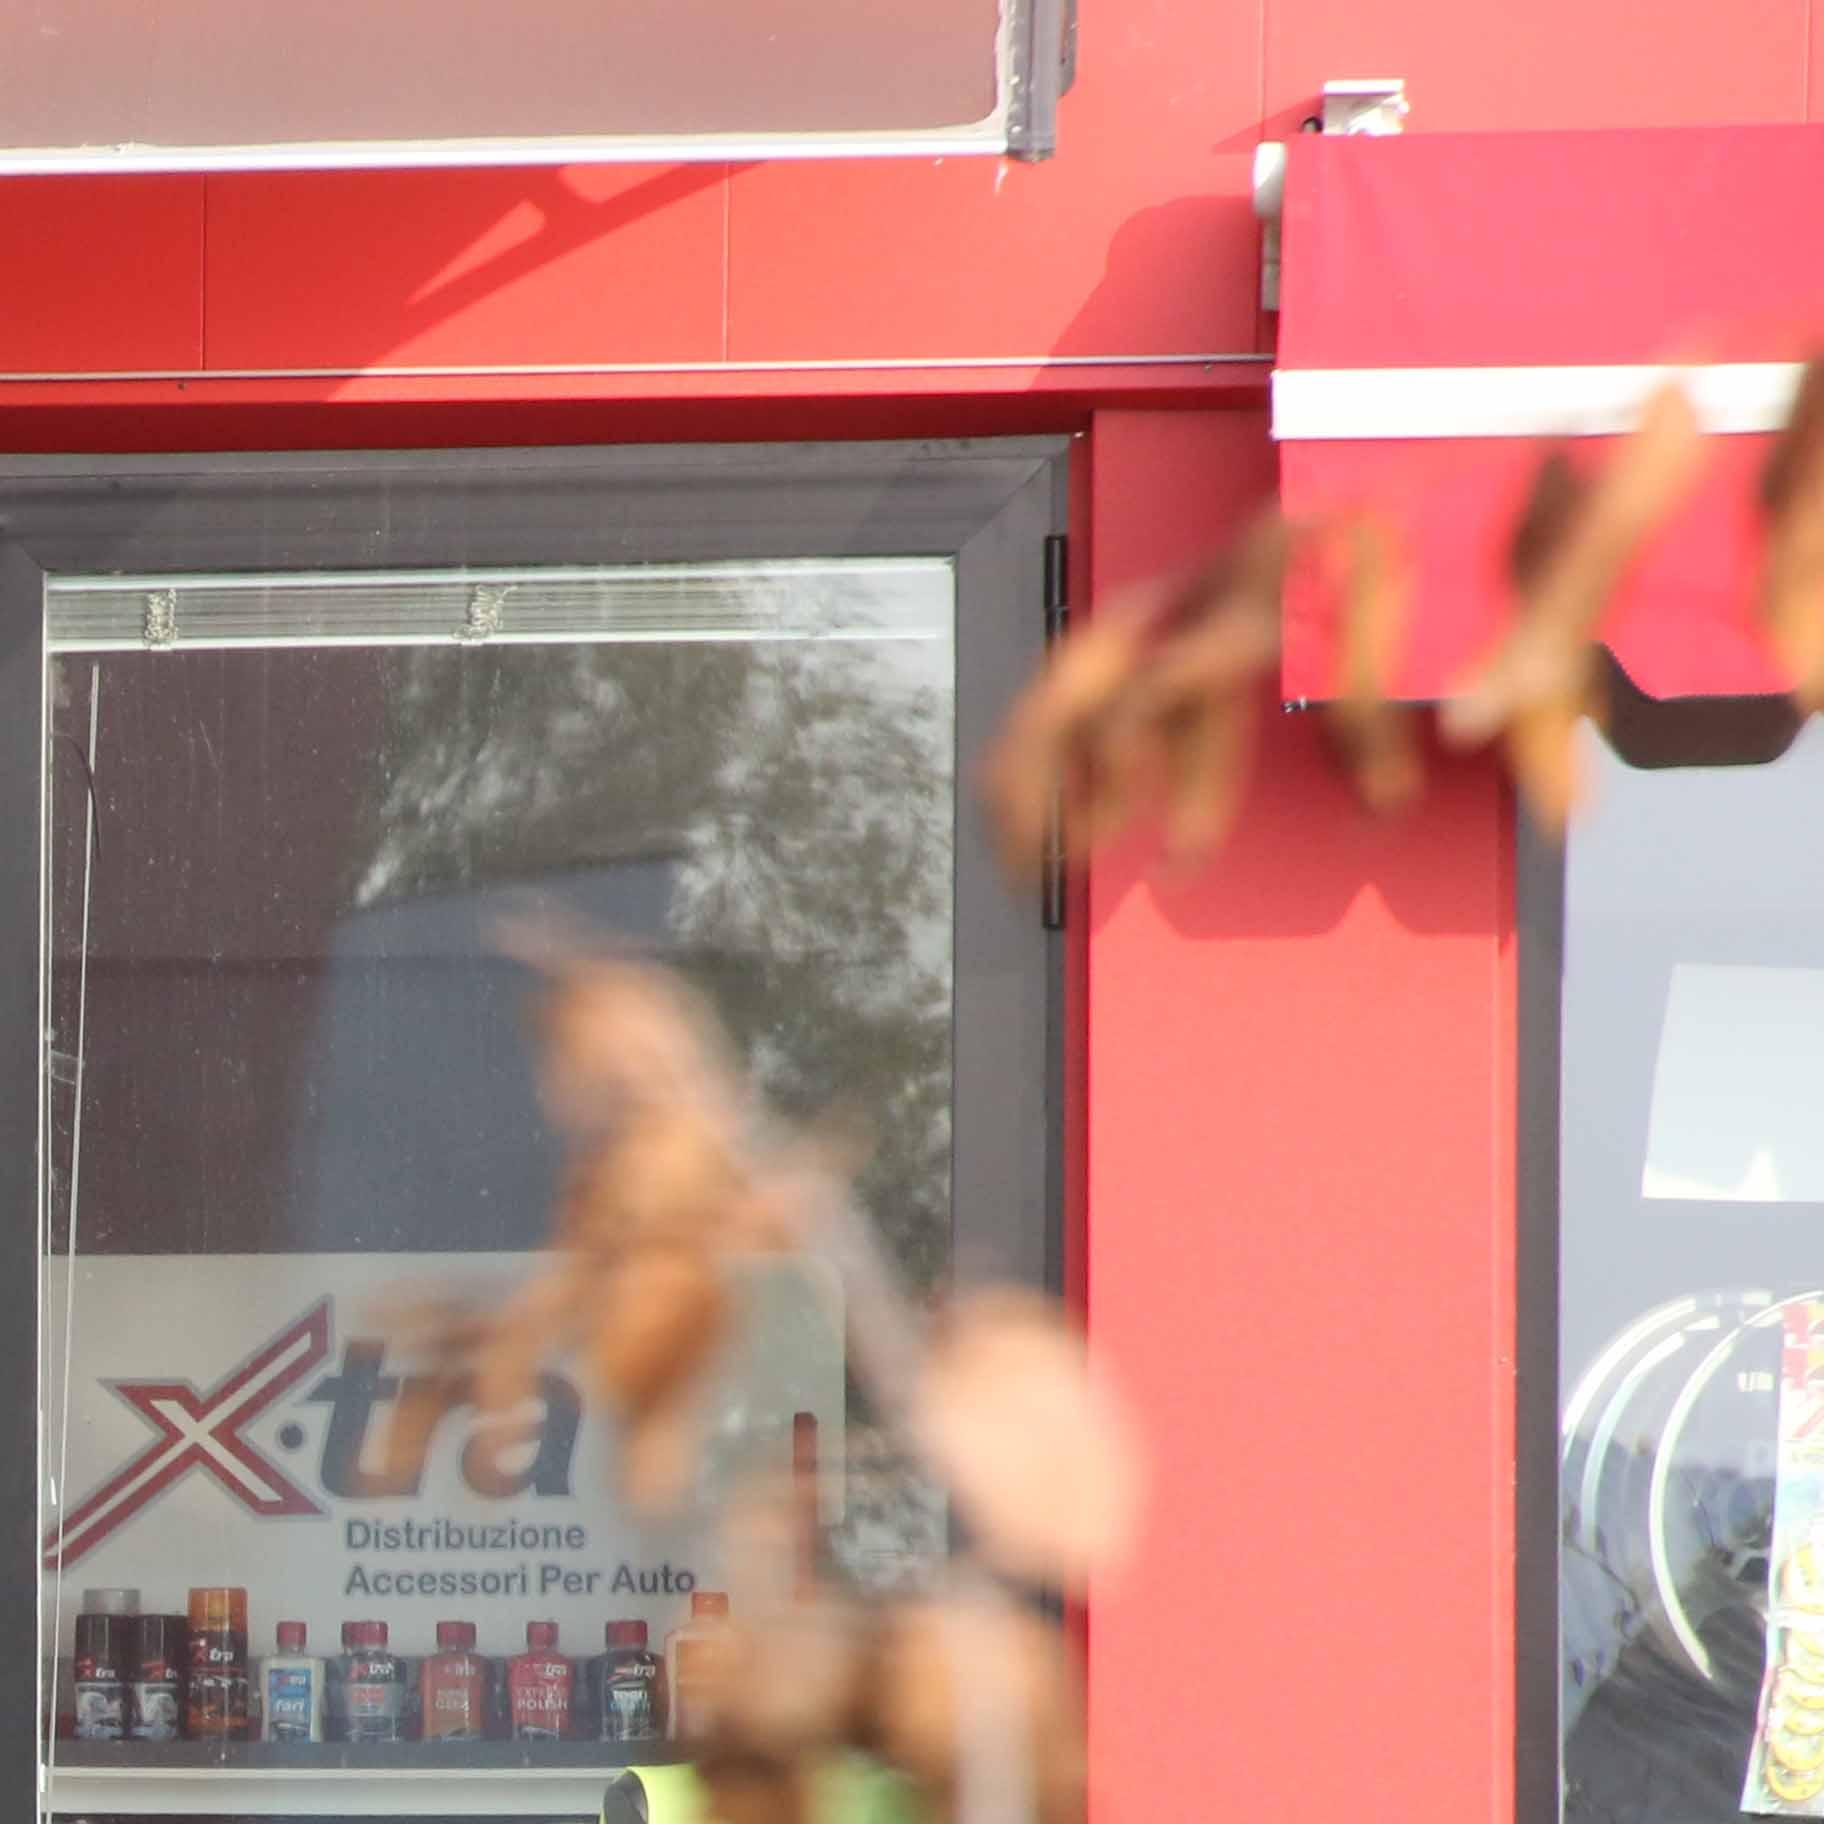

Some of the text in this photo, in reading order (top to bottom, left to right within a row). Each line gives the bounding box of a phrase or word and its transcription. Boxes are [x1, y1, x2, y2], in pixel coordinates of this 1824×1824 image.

[346, 1518, 586, 1551] Distribuzione
[345, 1562, 696, 1596] Accessori Per Auto
